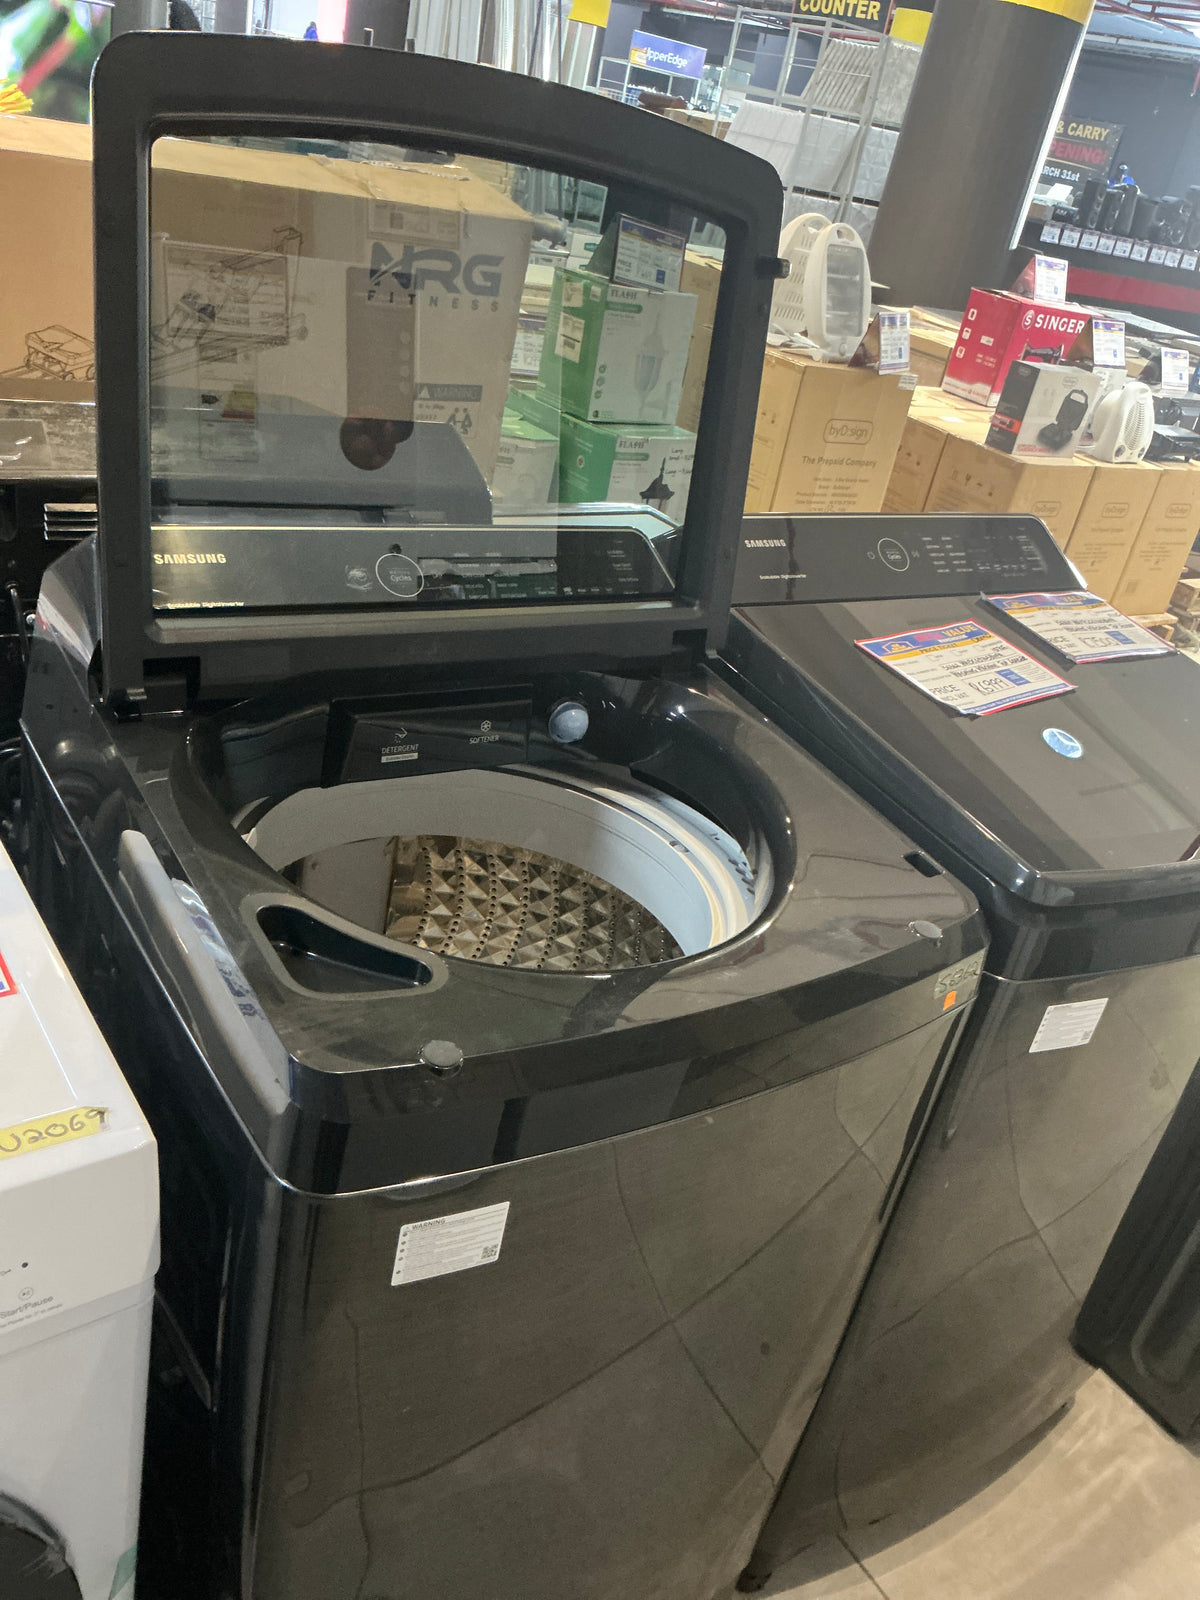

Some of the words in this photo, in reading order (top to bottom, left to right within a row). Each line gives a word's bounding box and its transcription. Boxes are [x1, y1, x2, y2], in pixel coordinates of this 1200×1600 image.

[800, 0, 881, 21] COUNTER
[1067, 122, 1111, 142] CARRY
[1050, 140, 1109, 165] PENING!
[1042, 165, 1061, 178] RCH
[1061, 169, 1080, 182] 31st
[369, 242, 506, 298] NRG
[367, 289, 500, 313] FITNESS
[1034, 313, 1086, 335] SINGER
[801, 455, 816, 465] The
[817, 456, 845, 467] Prepaid
[845, 457, 878, 468] Company
[744, 539, 786, 548] SAMSUNG
[154, 553, 227, 565] SAMSUNG
[943, 623, 977, 637] VALUE
[928, 683, 960, 696] PRICE
[469, 734, 500, 745] SOFTENER
[381, 743, 419, 754] DETERGENT
[412, 1218, 446, 1231] WARNING
